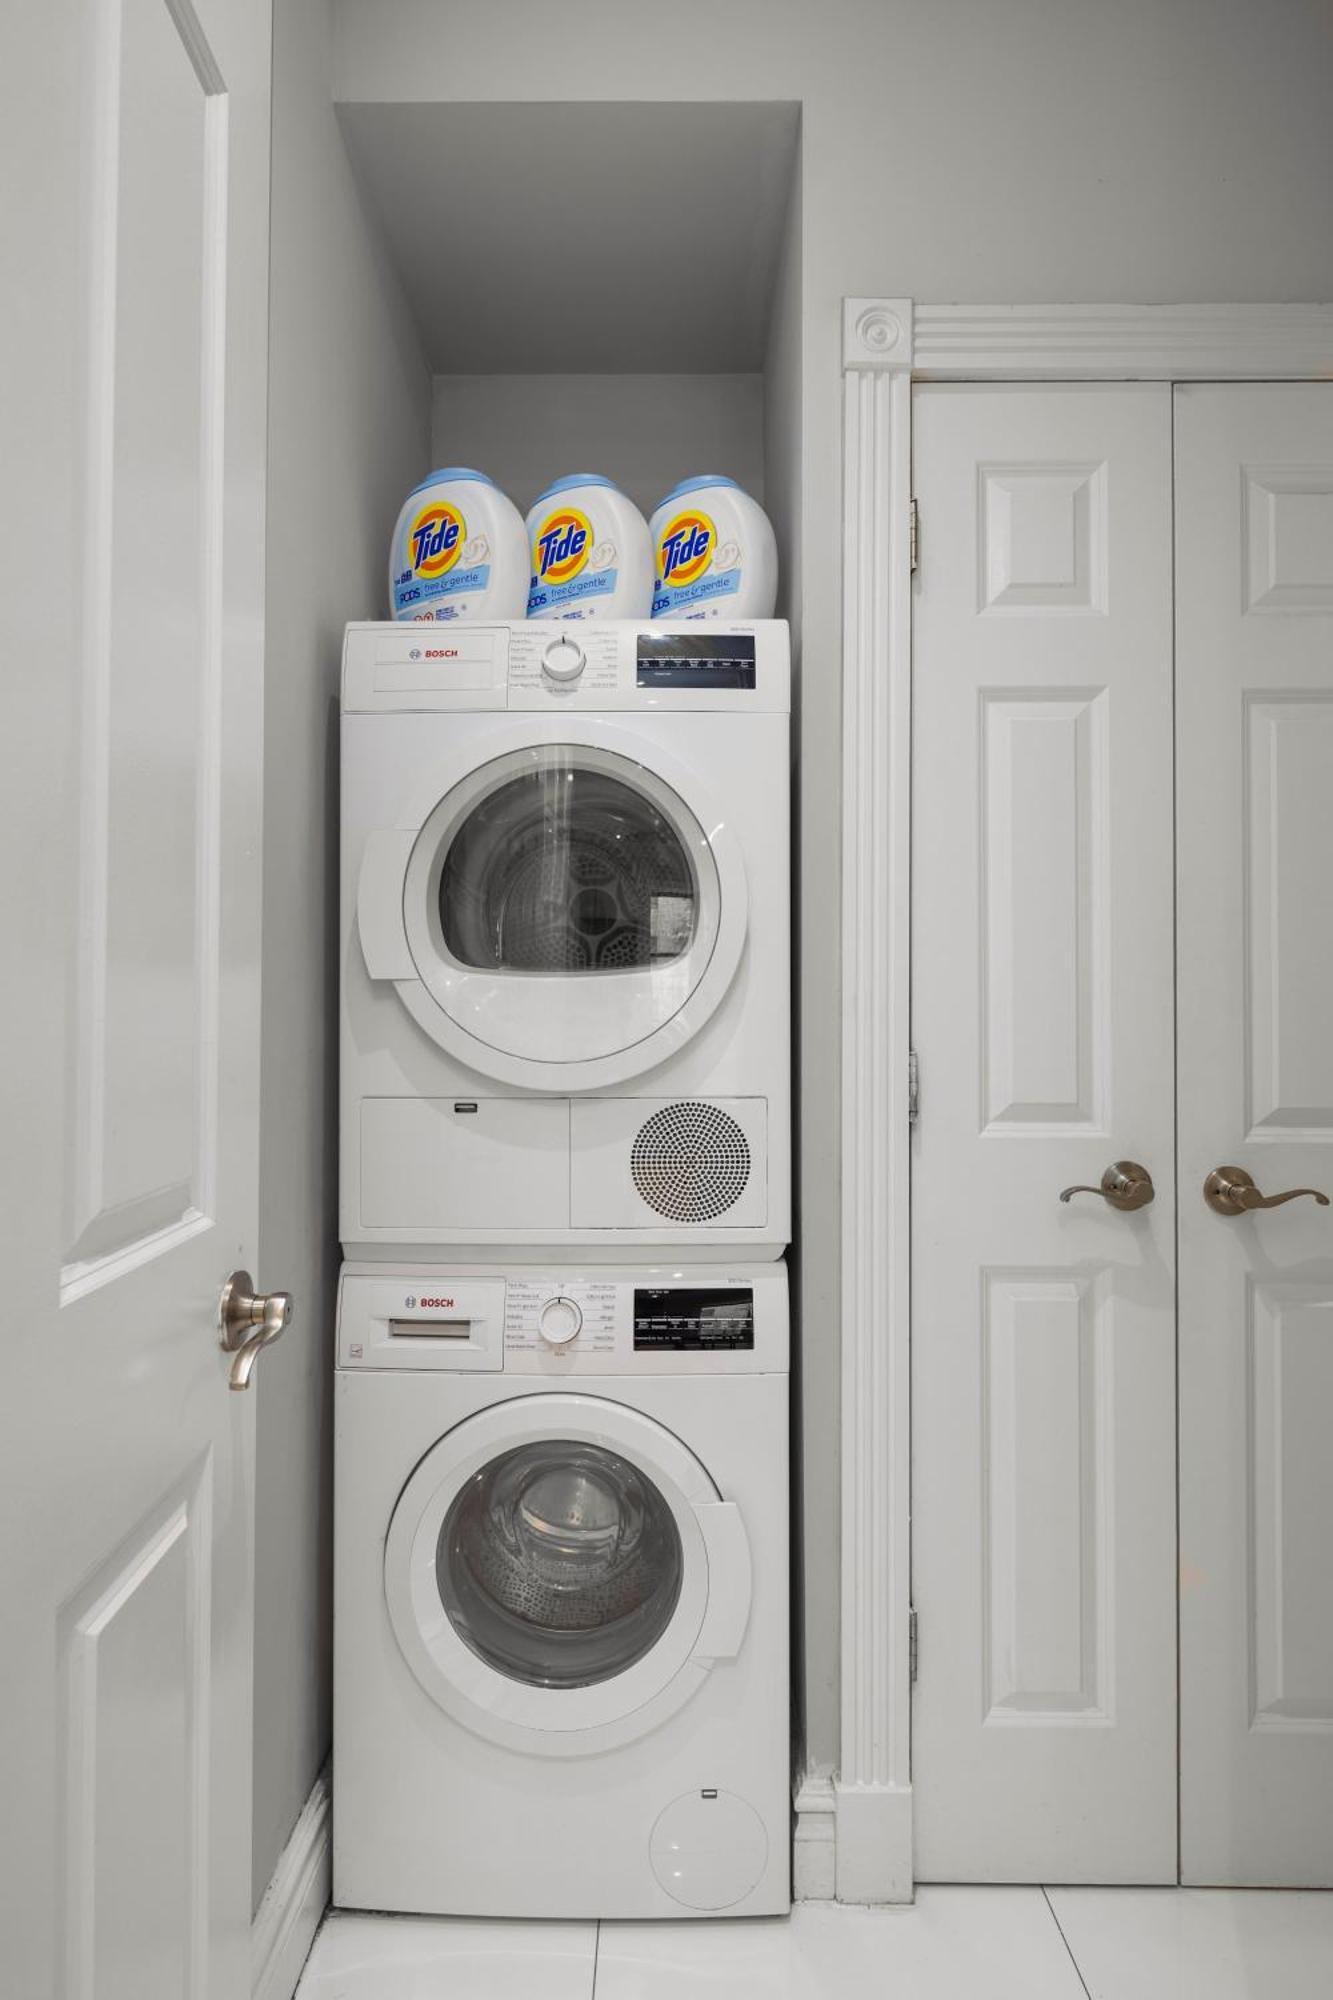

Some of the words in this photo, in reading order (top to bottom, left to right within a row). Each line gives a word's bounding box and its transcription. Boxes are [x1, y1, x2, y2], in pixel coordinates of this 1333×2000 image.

[413, 518, 459, 570] Tide
[539, 523, 586, 576] Tide
[662, 525, 710, 580] Tide
[551, 588, 567, 598] free
[576, 577, 607, 592] gentle
[673, 590, 690, 600] free
[699, 578, 730, 593] gentle
[425, 650, 458, 658] BOSCH
[420, 1298, 454, 1308] BOSCH
